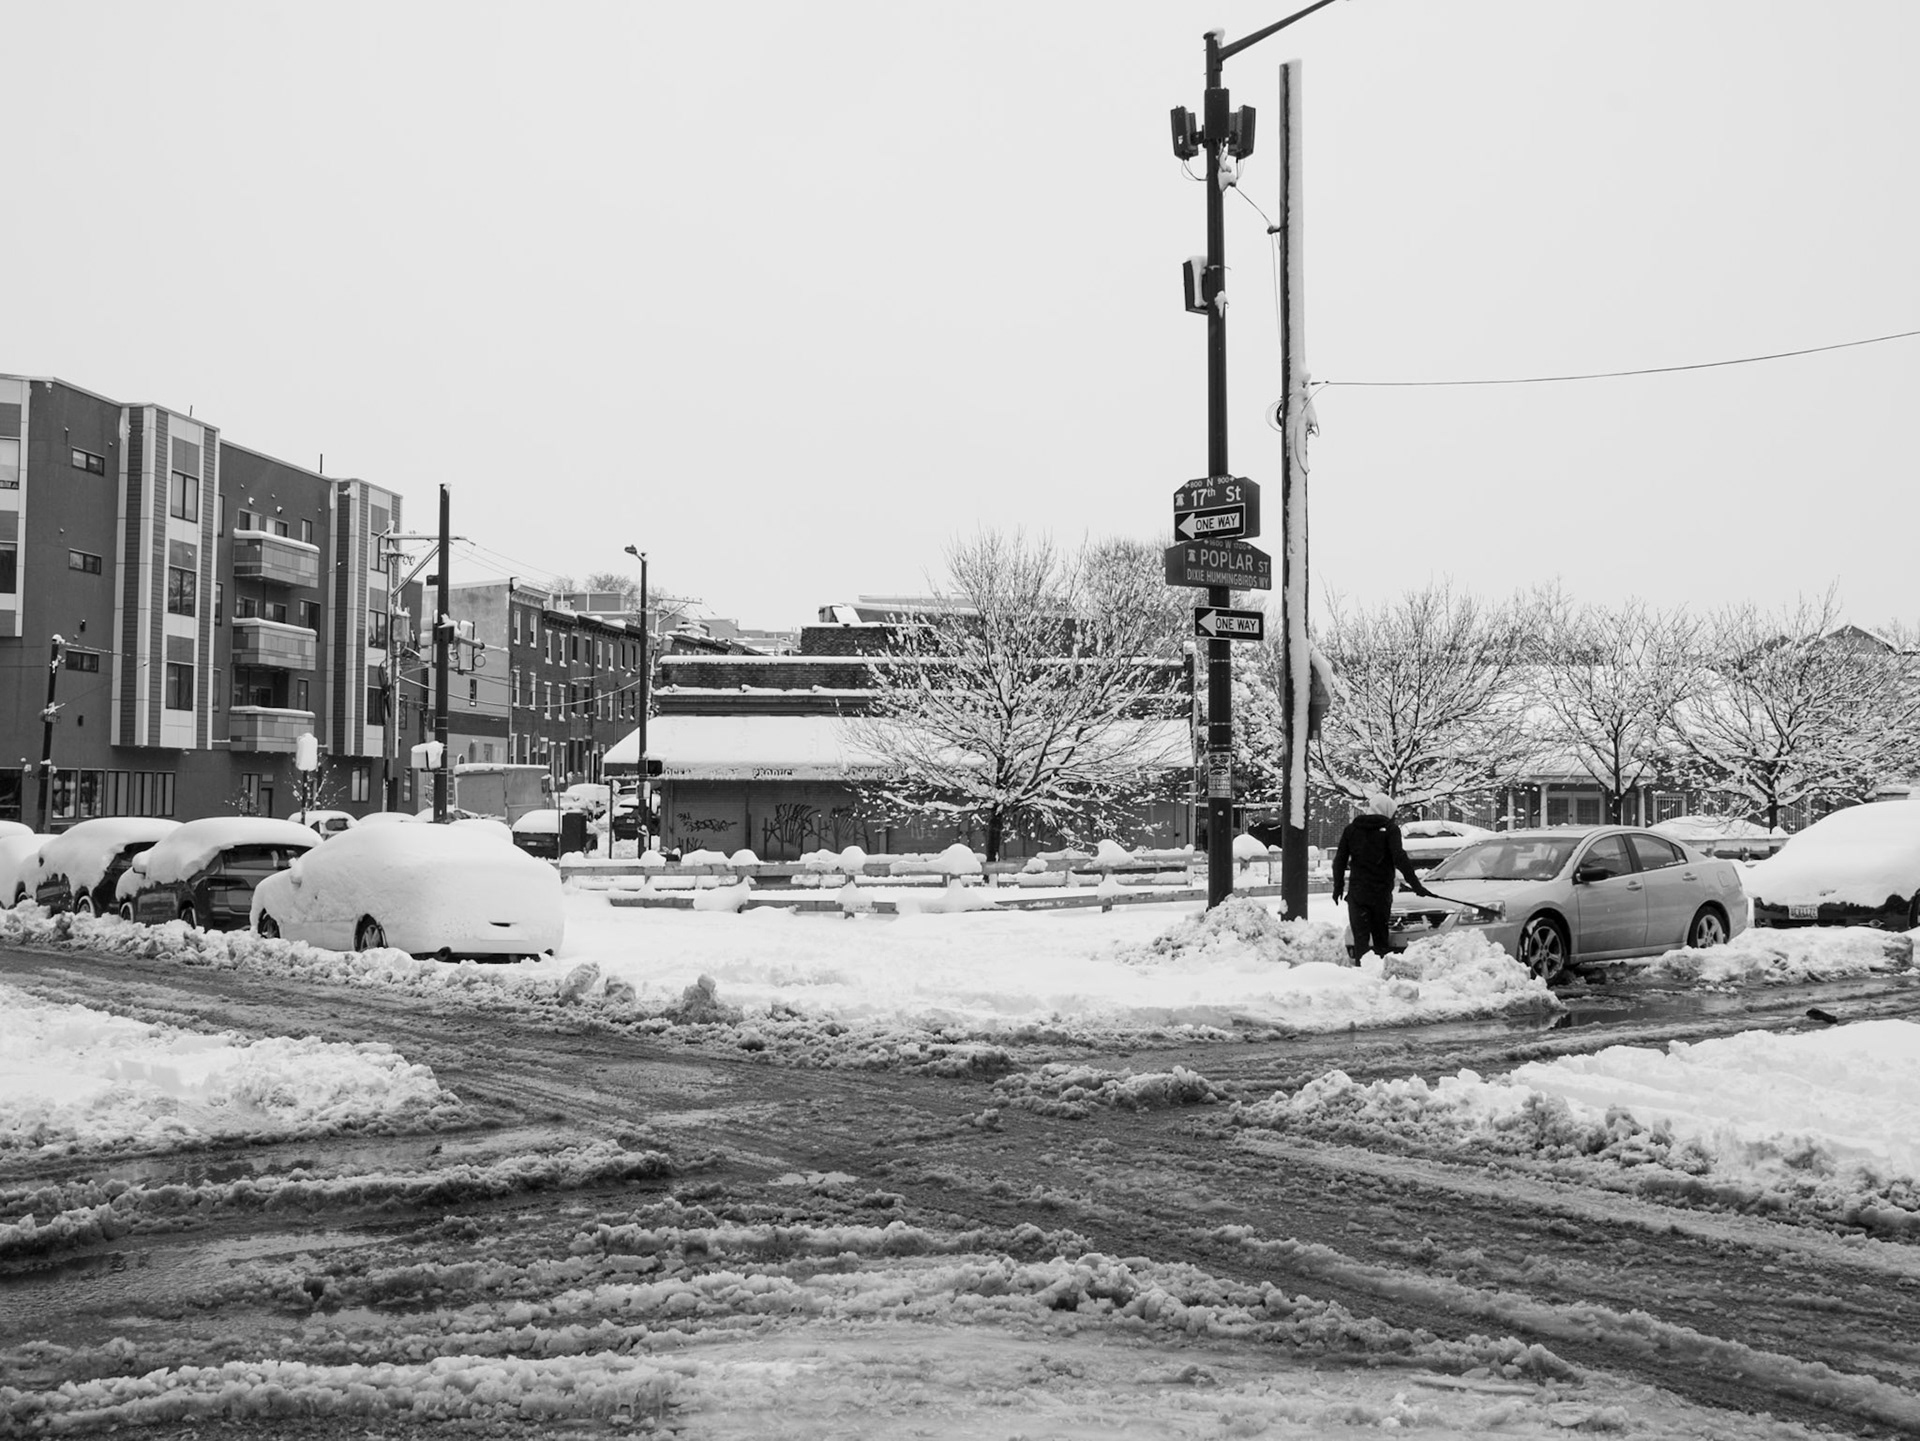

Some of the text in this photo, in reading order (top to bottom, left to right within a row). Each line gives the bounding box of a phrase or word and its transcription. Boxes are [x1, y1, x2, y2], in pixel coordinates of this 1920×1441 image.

[1206, 478, 1213, 487] N
[1191, 485, 1241, 507] 17th St
[1195, 514, 1237, 531] ONE WAY
[1225, 540, 1232, 549] W
[1200, 549, 1269, 573] POPLAR ST
[1187, 568, 1269, 588] DIXIE HUMMINGBIRDS WY
[1215, 617, 1257, 632] ONE WAY
